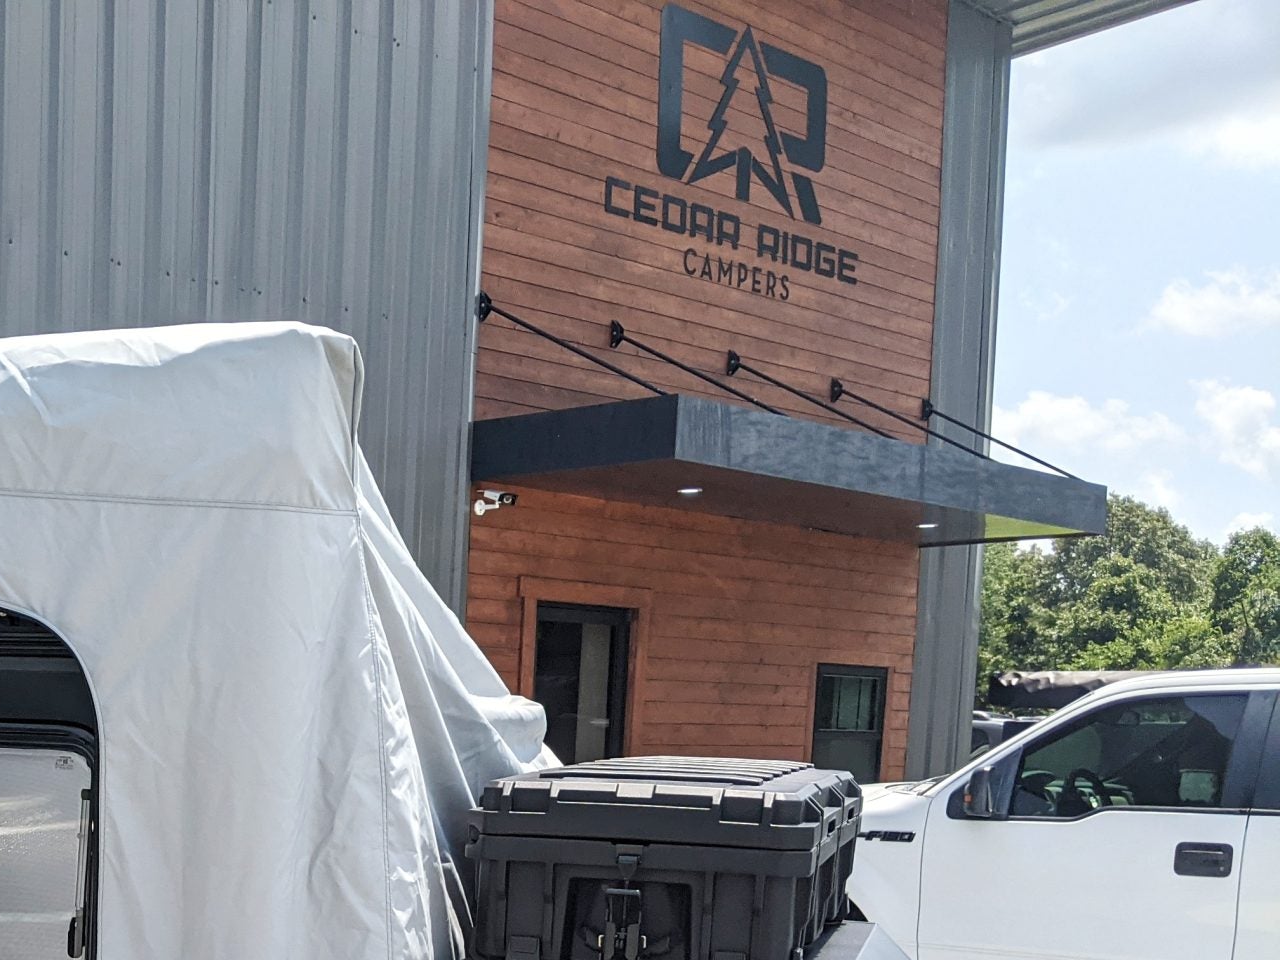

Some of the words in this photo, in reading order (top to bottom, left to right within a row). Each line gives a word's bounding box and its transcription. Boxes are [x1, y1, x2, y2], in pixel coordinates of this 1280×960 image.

[604, 176, 740, 250] CEDAR
[757, 223, 858, 285] RIDGE
[683, 248, 790, 300] CAMPERS
